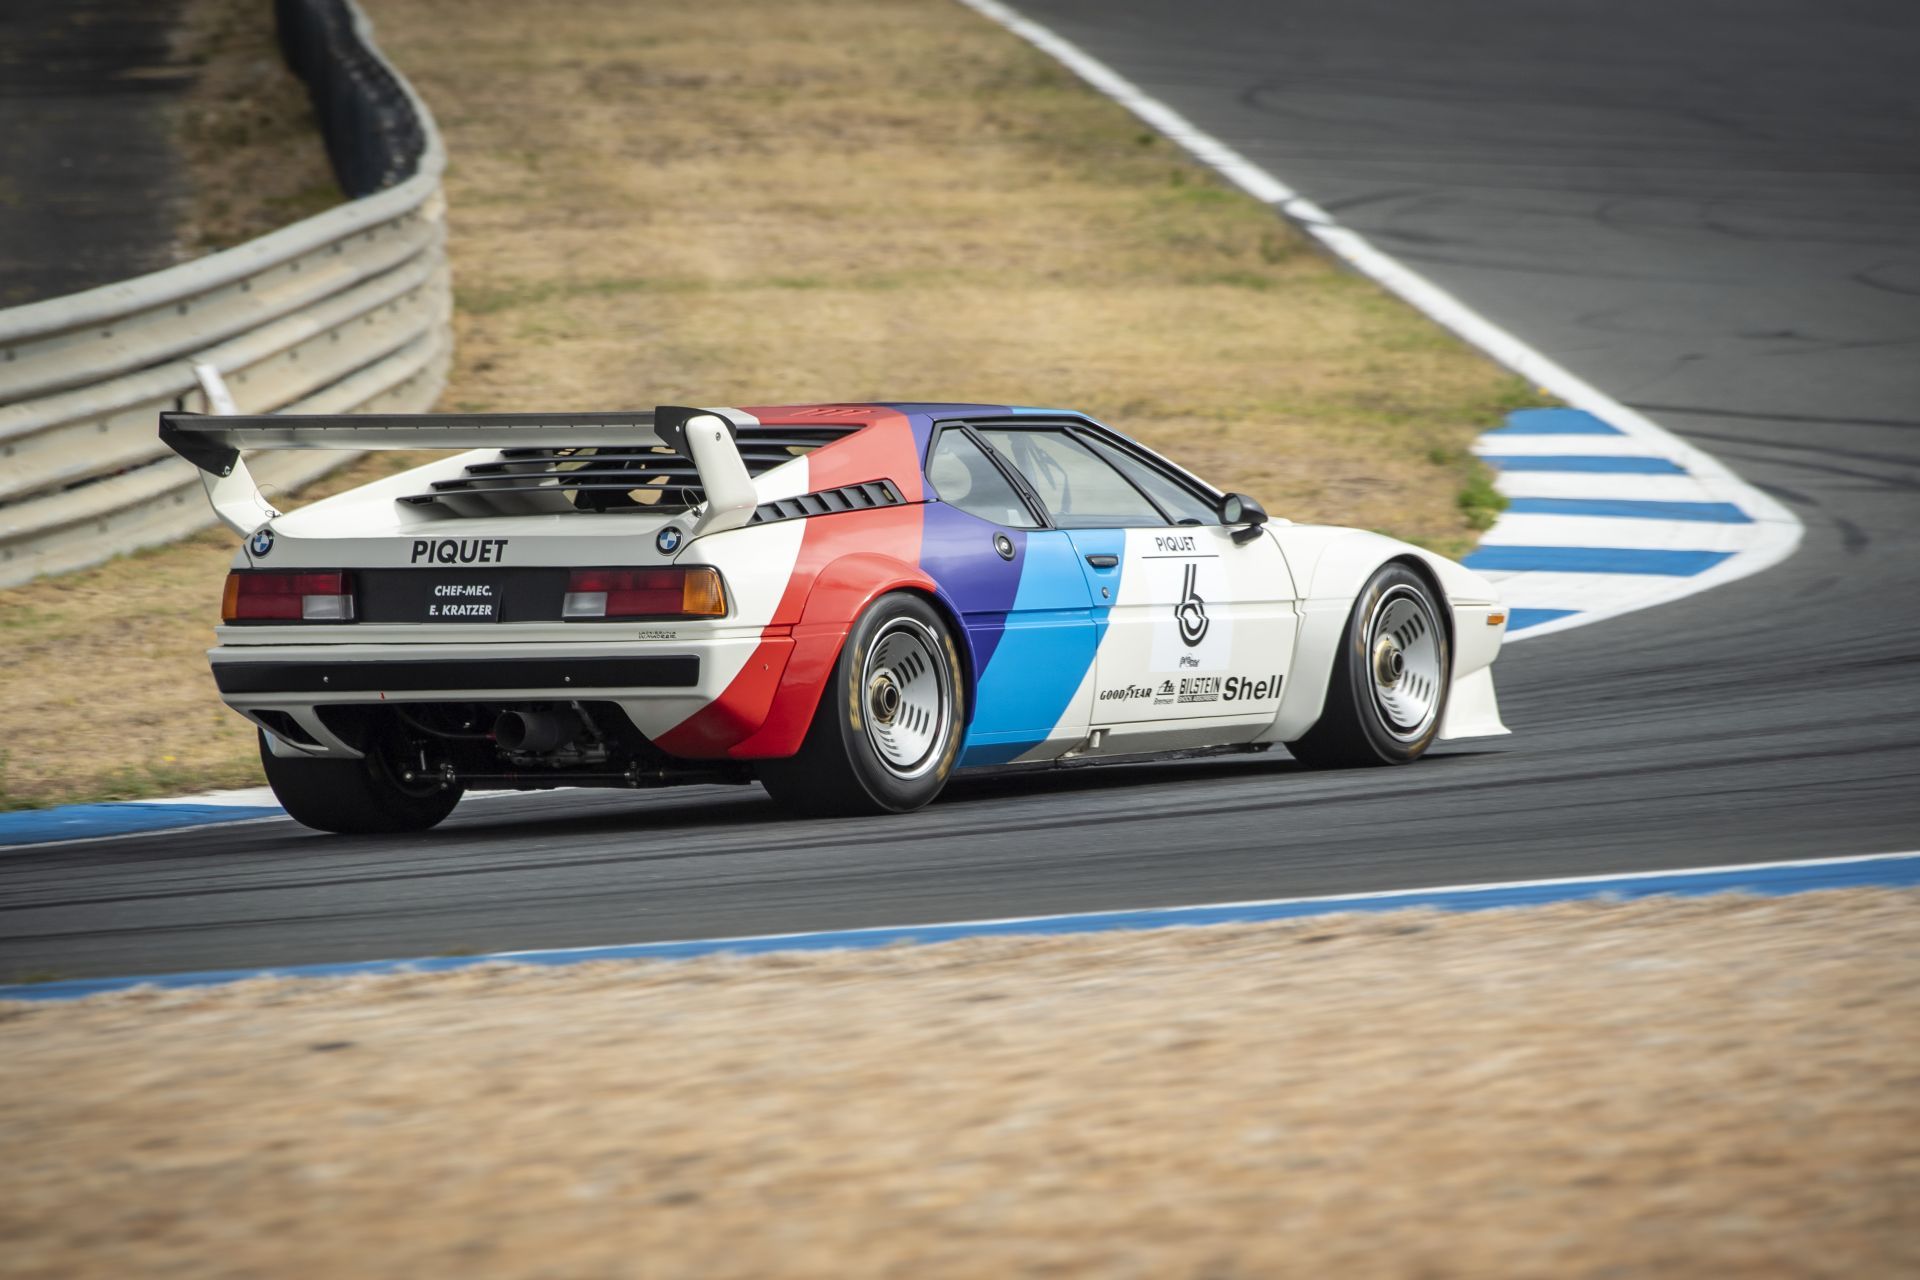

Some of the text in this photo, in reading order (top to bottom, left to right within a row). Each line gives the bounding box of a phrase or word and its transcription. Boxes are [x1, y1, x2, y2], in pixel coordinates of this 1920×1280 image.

[411, 539, 508, 564] PIQUET
[1155, 536, 1196, 551] PIQUET
[434, 585, 492, 596] CHEF-MEC.
[429, 605, 492, 616] E. KRATZER
[1174, 563, 1209, 648] 6
[1179, 677, 1221, 694] BILSTEIN
[1222, 674, 1283, 701] Shell
